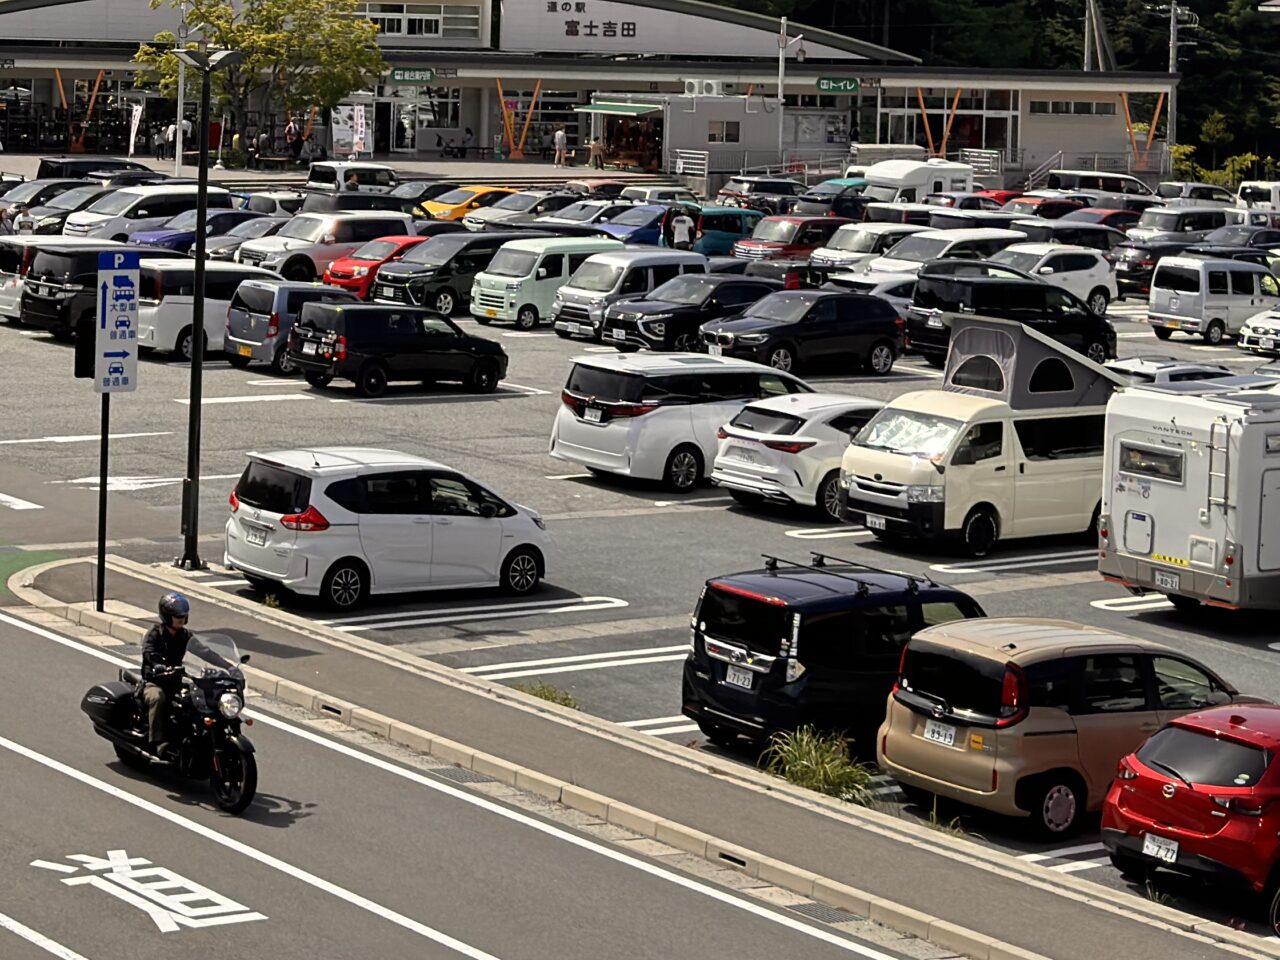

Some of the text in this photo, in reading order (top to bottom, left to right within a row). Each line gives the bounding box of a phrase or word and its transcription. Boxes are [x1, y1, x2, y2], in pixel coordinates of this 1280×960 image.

[547, 1, 586, 13] 道の駅
[564, 19, 636, 37] 富士吉田
[829, 79, 855, 90] トイレ
[114, 253, 125, 268] P
[110, 302, 137, 312] 大型車
[110, 329, 136, 339] 普通車
[102, 376, 129, 386] 普通車
[1152, 425, 1193, 436] VANTECH
[732, 673, 751, 687] 71-23
[29, 849, 270, 933] 道
